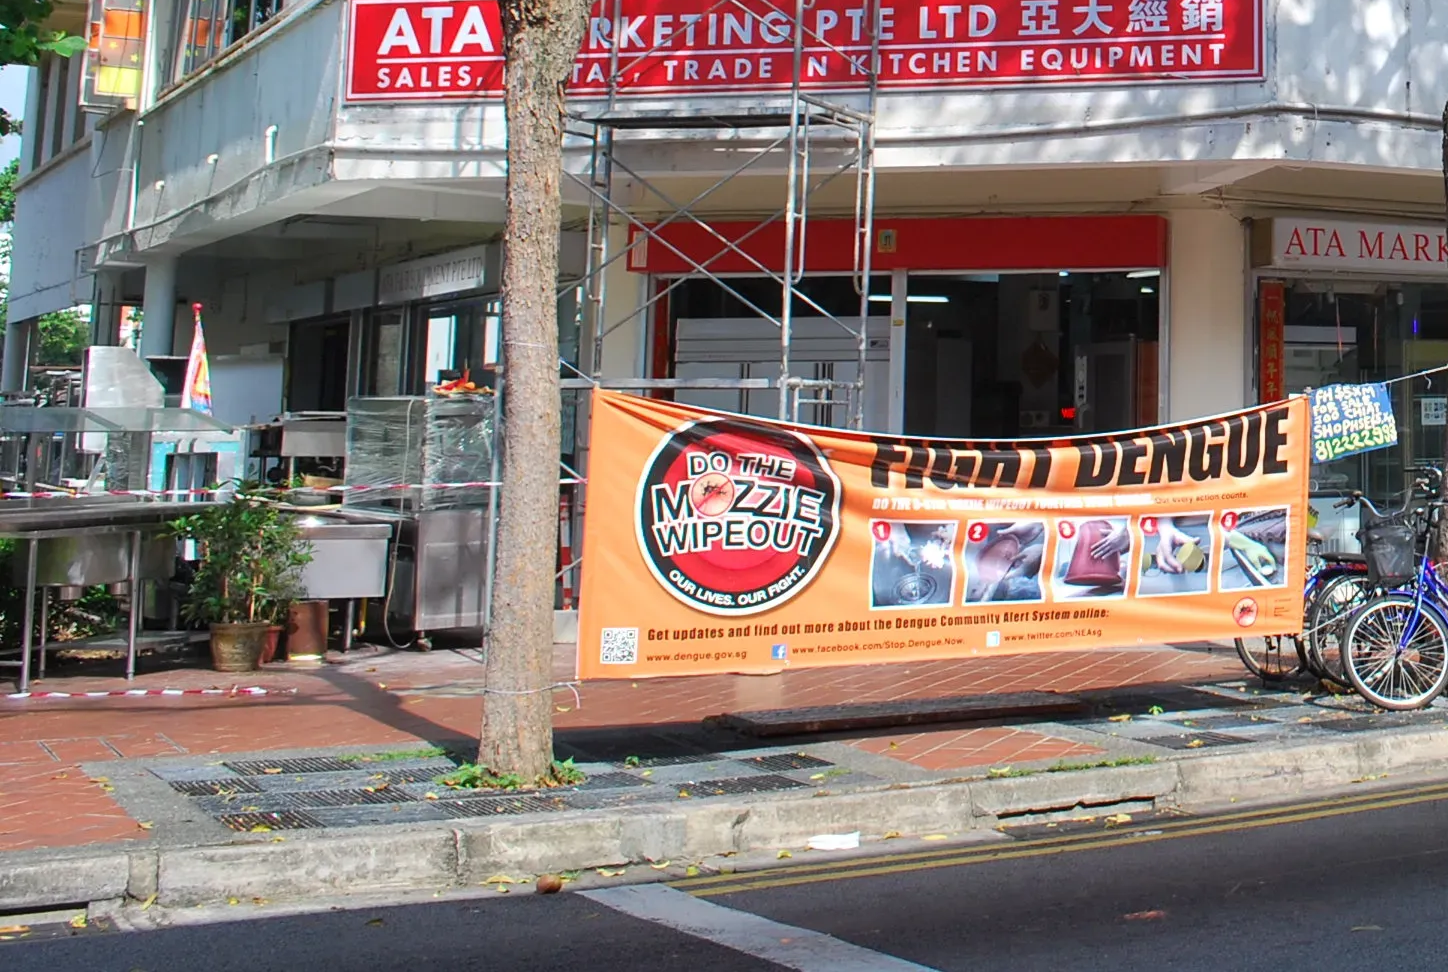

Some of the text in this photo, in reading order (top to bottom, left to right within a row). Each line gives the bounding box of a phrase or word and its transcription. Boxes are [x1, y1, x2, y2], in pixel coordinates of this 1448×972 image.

[376, 3, 997, 55] ATA RKETING PTE LTD
[376, 64, 485, 89] SALES,
[664, 58, 772, 80] TRADE
[806, 55, 828, 78] N
[850, 51, 998, 76] KITCHEN
[1020, 42, 1225, 71] EQUIPMENT
[1284, 226, 1347, 257] ATA
[1313, 395, 1371, 417] FOR SALE
[1316, 387, 1333, 407] FH
[1074, 407, 1289, 488] DENGUE
[689, 453, 796, 479] DO THE
[653, 472, 825, 525] MOZZIE
[1195, 493, 1220, 502] action
[1221, 491, 1249, 501] counts.
[653, 518, 823, 556] WIPEOUT
[877, 524, 885, 537] 1
[973, 525, 983, 539] 2
[669, 565, 806, 606] OUR LIVES. OUR FIGHT.
[647, 607, 1110, 642] Get updates and find out more about the Dengue Community Alert System online:
[646, 650, 748, 662] www.dengue.gov.sg
[1003, 628, 1103, 642] www.twitter.com/NEAsg
